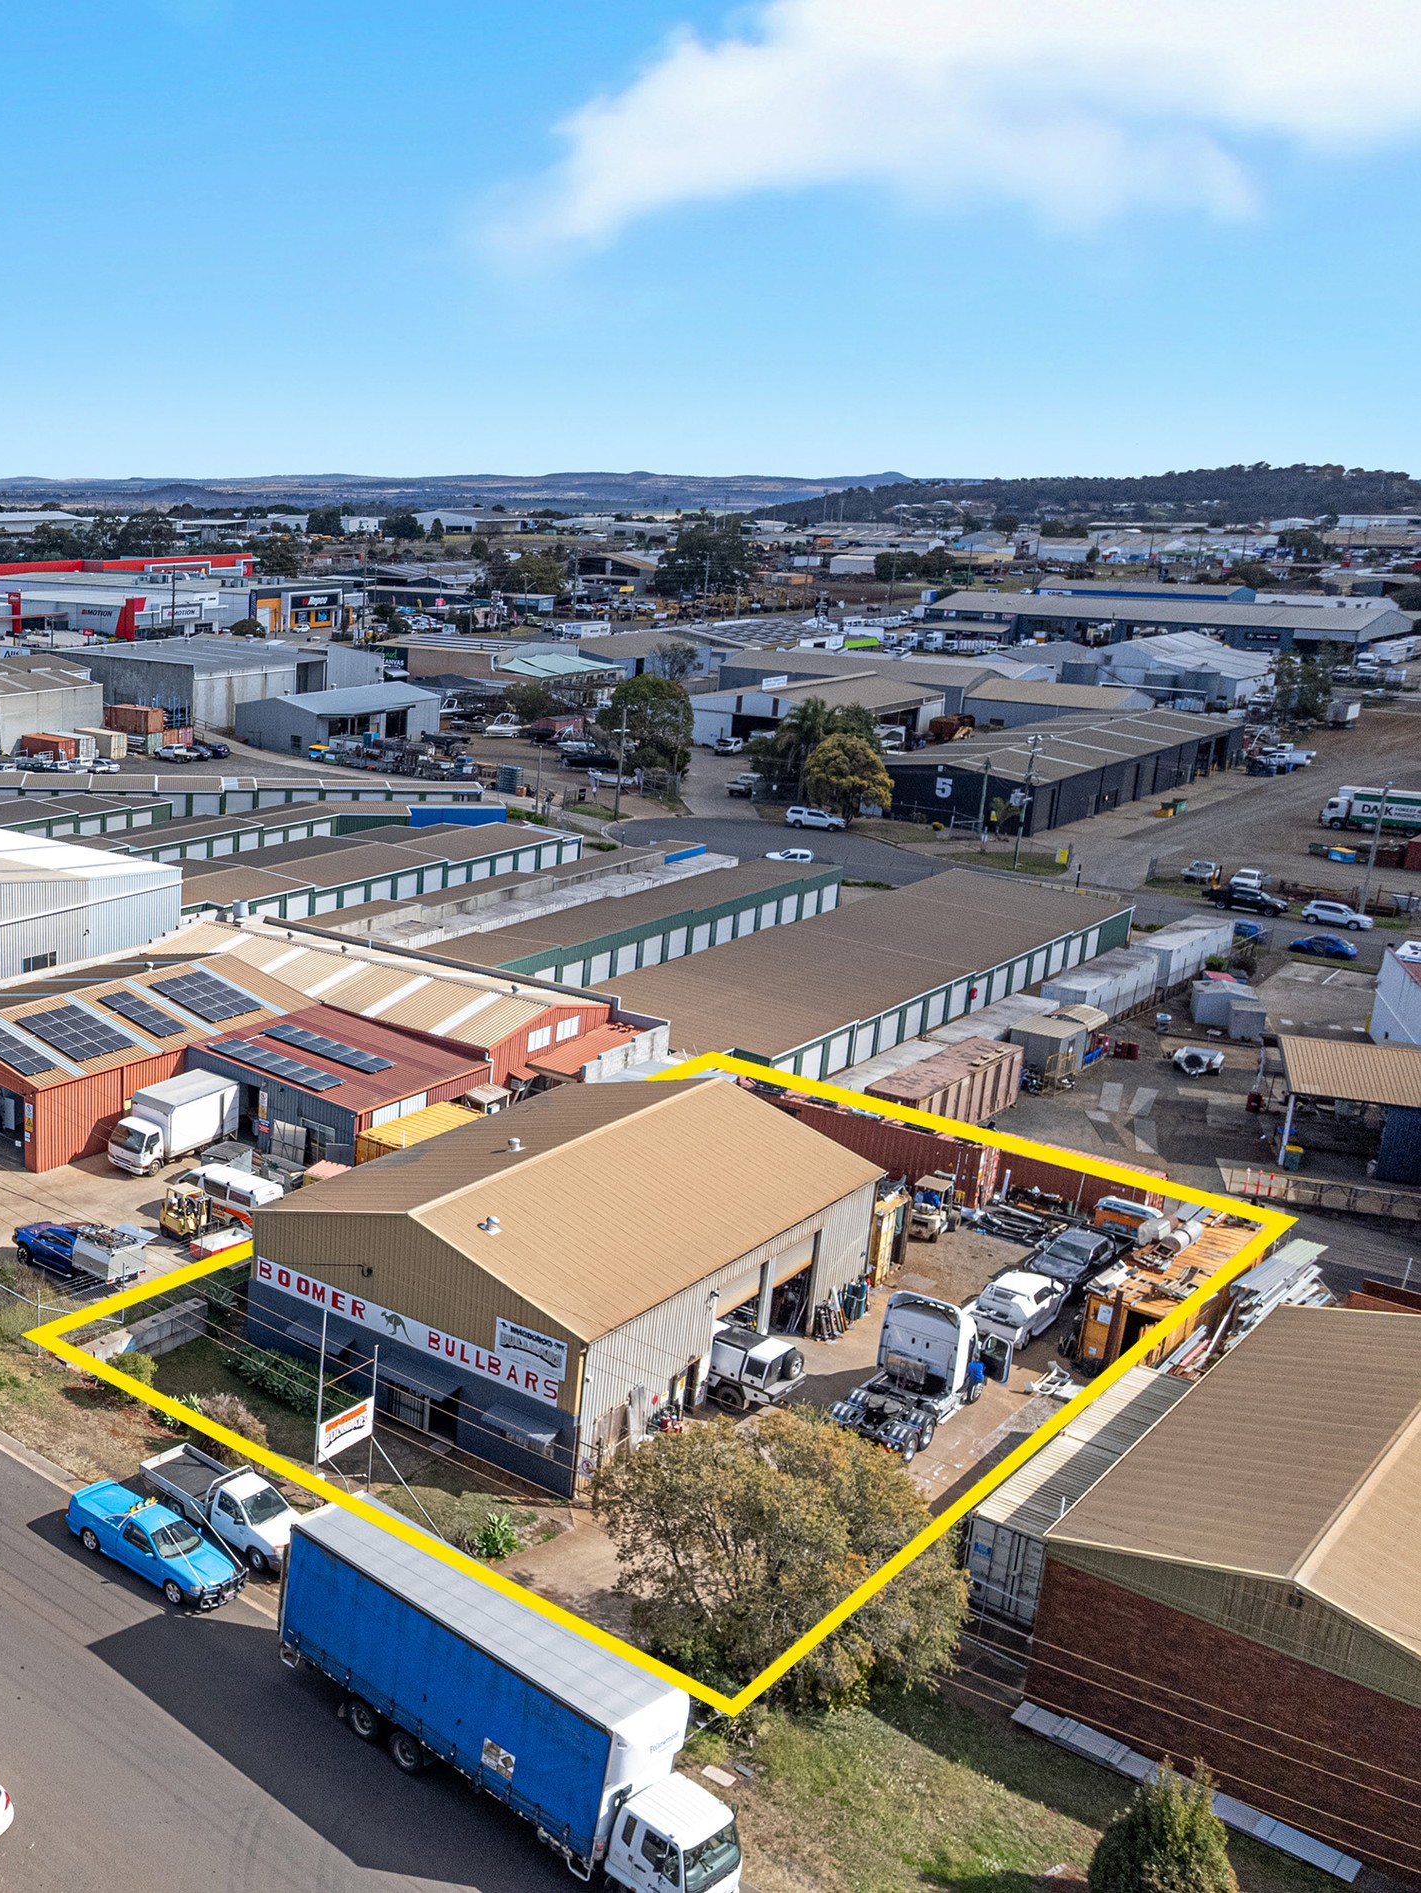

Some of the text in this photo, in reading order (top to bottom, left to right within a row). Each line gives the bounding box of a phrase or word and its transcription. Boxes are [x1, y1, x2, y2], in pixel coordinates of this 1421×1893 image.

[935, 777, 953, 799] 5
[259, 1260, 366, 1320] BOOMER
[428, 1330, 559, 1400] BULLBARS
